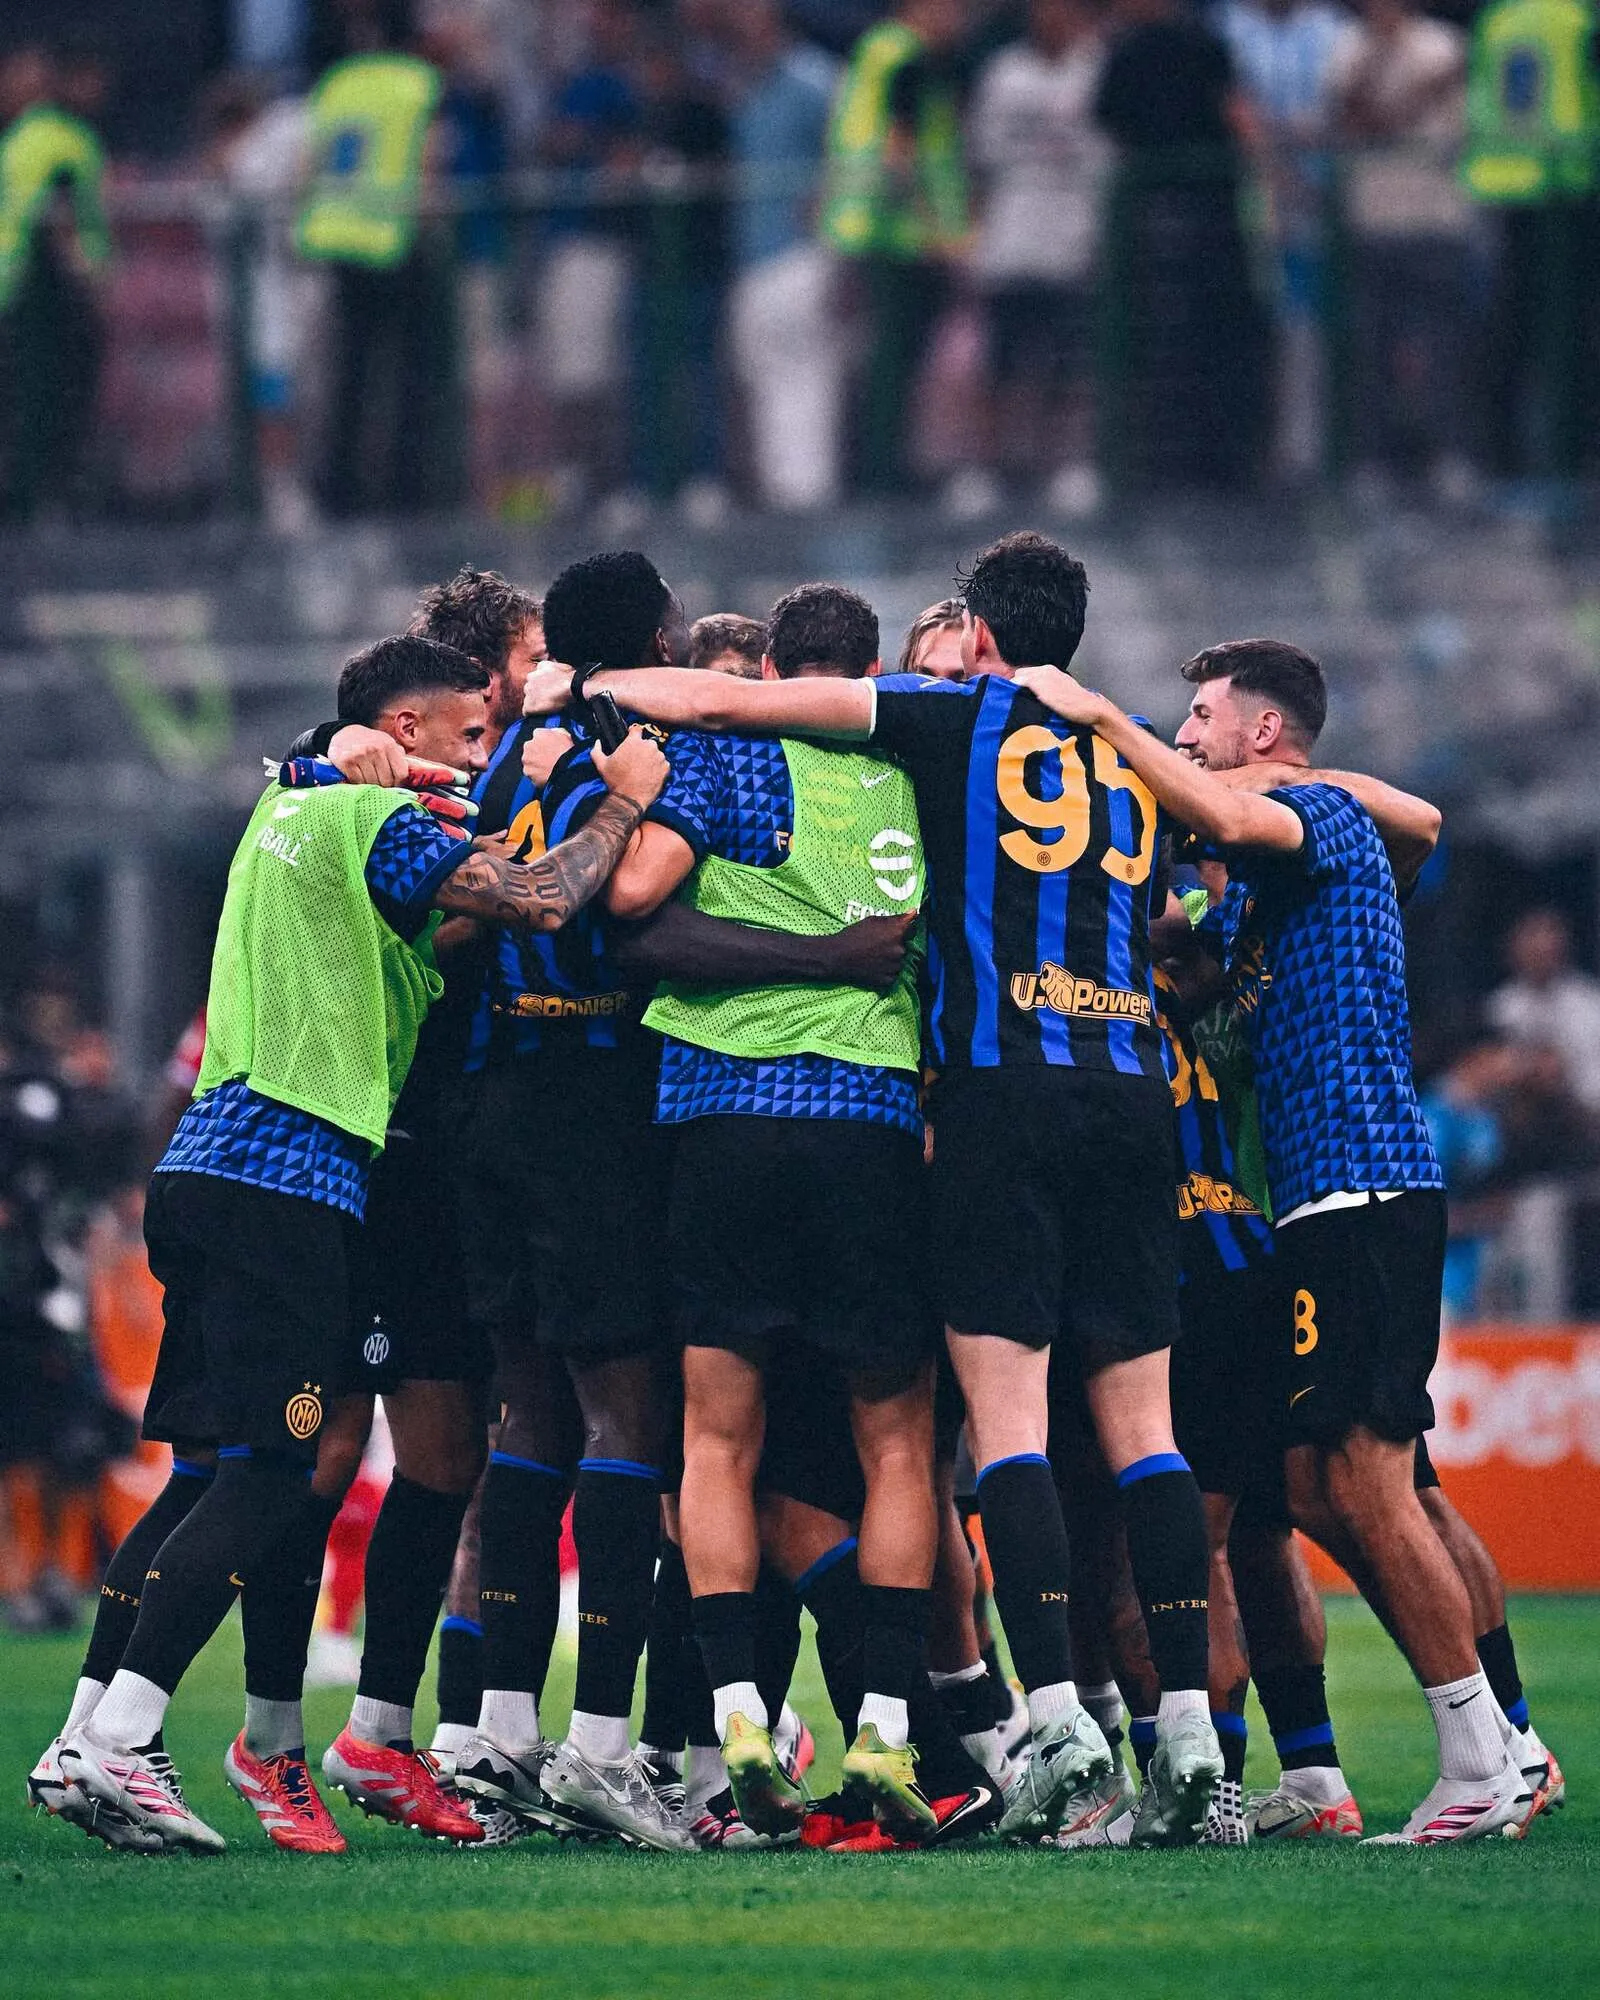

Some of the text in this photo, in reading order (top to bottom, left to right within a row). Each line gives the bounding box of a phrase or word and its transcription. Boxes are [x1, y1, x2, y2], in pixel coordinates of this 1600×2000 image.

[101, 1584, 143, 1608] INTE
[481, 1591, 517, 1603] TER
[1039, 1592, 1068, 1603] INT
[1152, 1600, 1209, 1613] INTER
